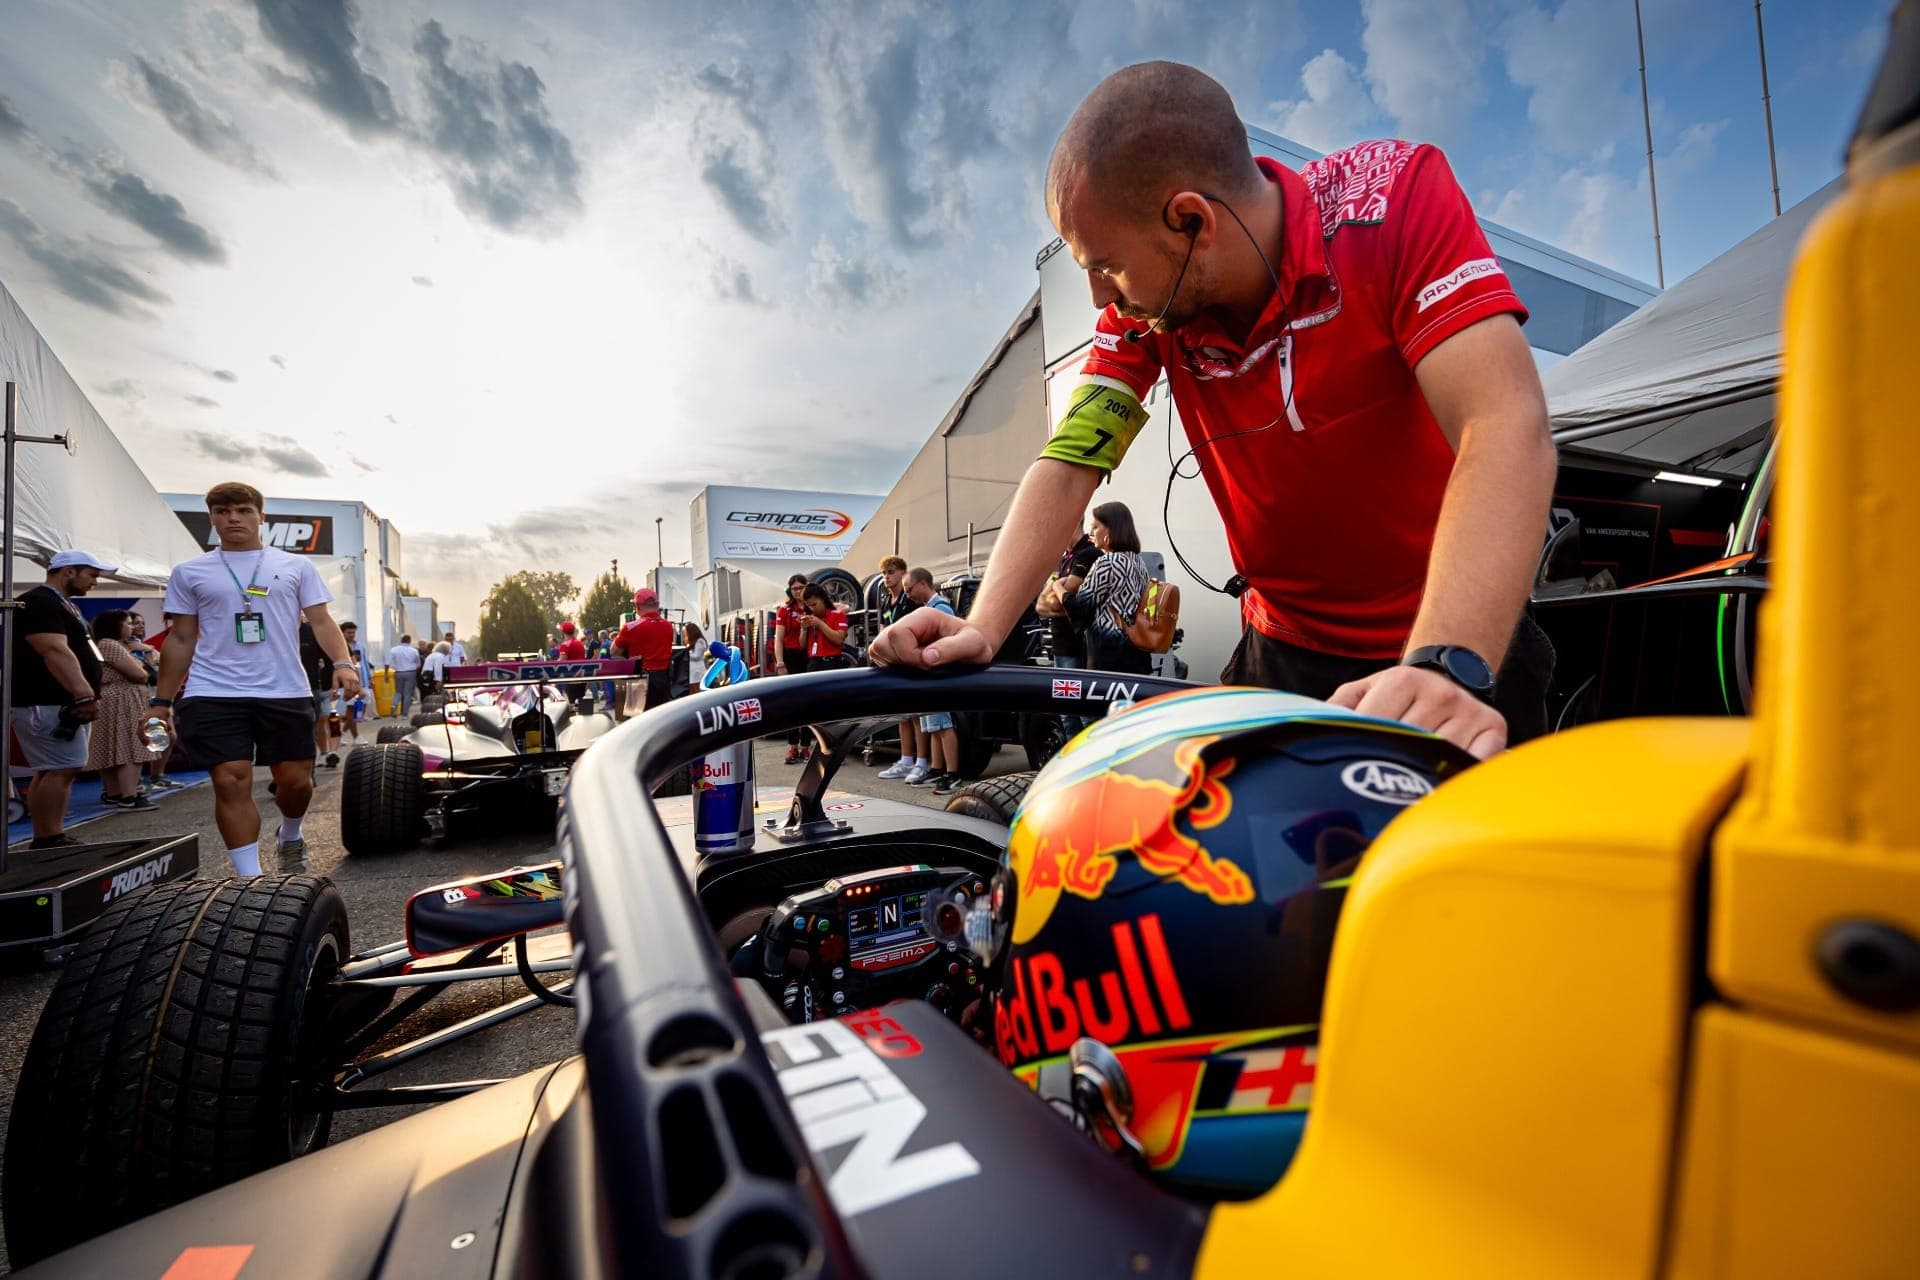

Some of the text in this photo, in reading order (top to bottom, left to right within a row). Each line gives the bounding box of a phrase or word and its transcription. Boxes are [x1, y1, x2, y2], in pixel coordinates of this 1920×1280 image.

[1423, 262, 1497, 302] RAVENOL
[1104, 398, 1131, 422] 2024
[1082, 428, 1115, 457] 7
[520, 663, 600, 681] BWT
[1086, 681, 1140, 701] LIN
[695, 702, 735, 736] LIN
[704, 762, 731, 778] Bull
[103, 853, 174, 903] TRIDENT
[884, 903, 898, 924] N
[862, 947, 926, 968] PREMA
